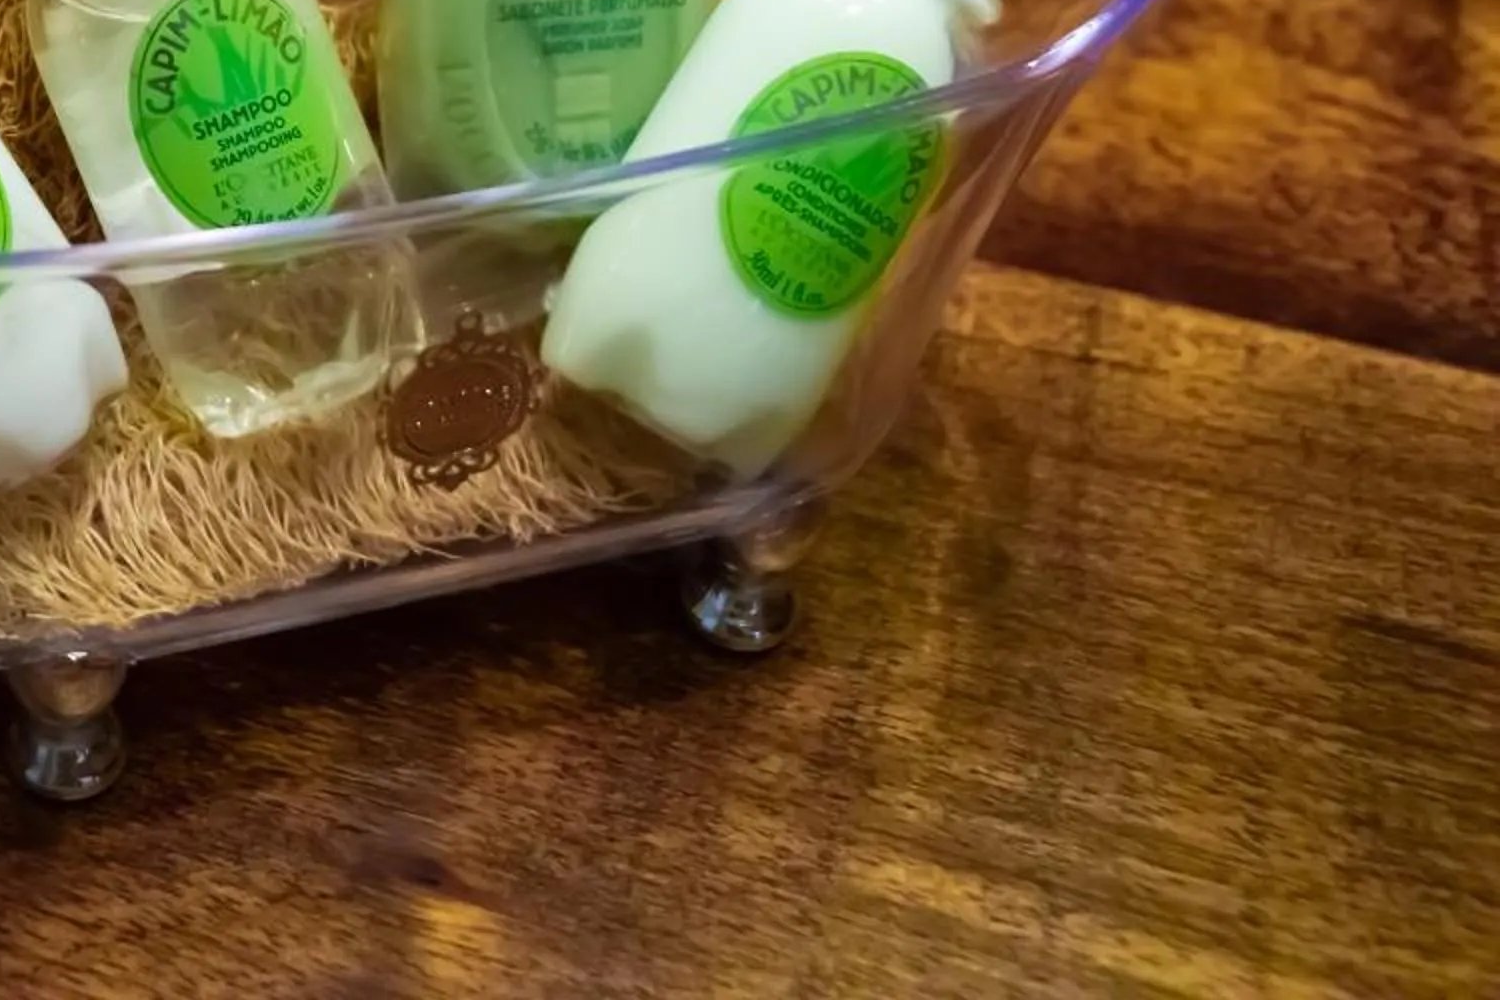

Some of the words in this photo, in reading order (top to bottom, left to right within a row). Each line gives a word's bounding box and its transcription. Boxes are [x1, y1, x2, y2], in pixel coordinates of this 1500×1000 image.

[193, 88, 292, 140] SHAMPOO
[217, 116, 285, 152] SHAMPOO
[210, 125, 302, 172] SHAMPOOING
